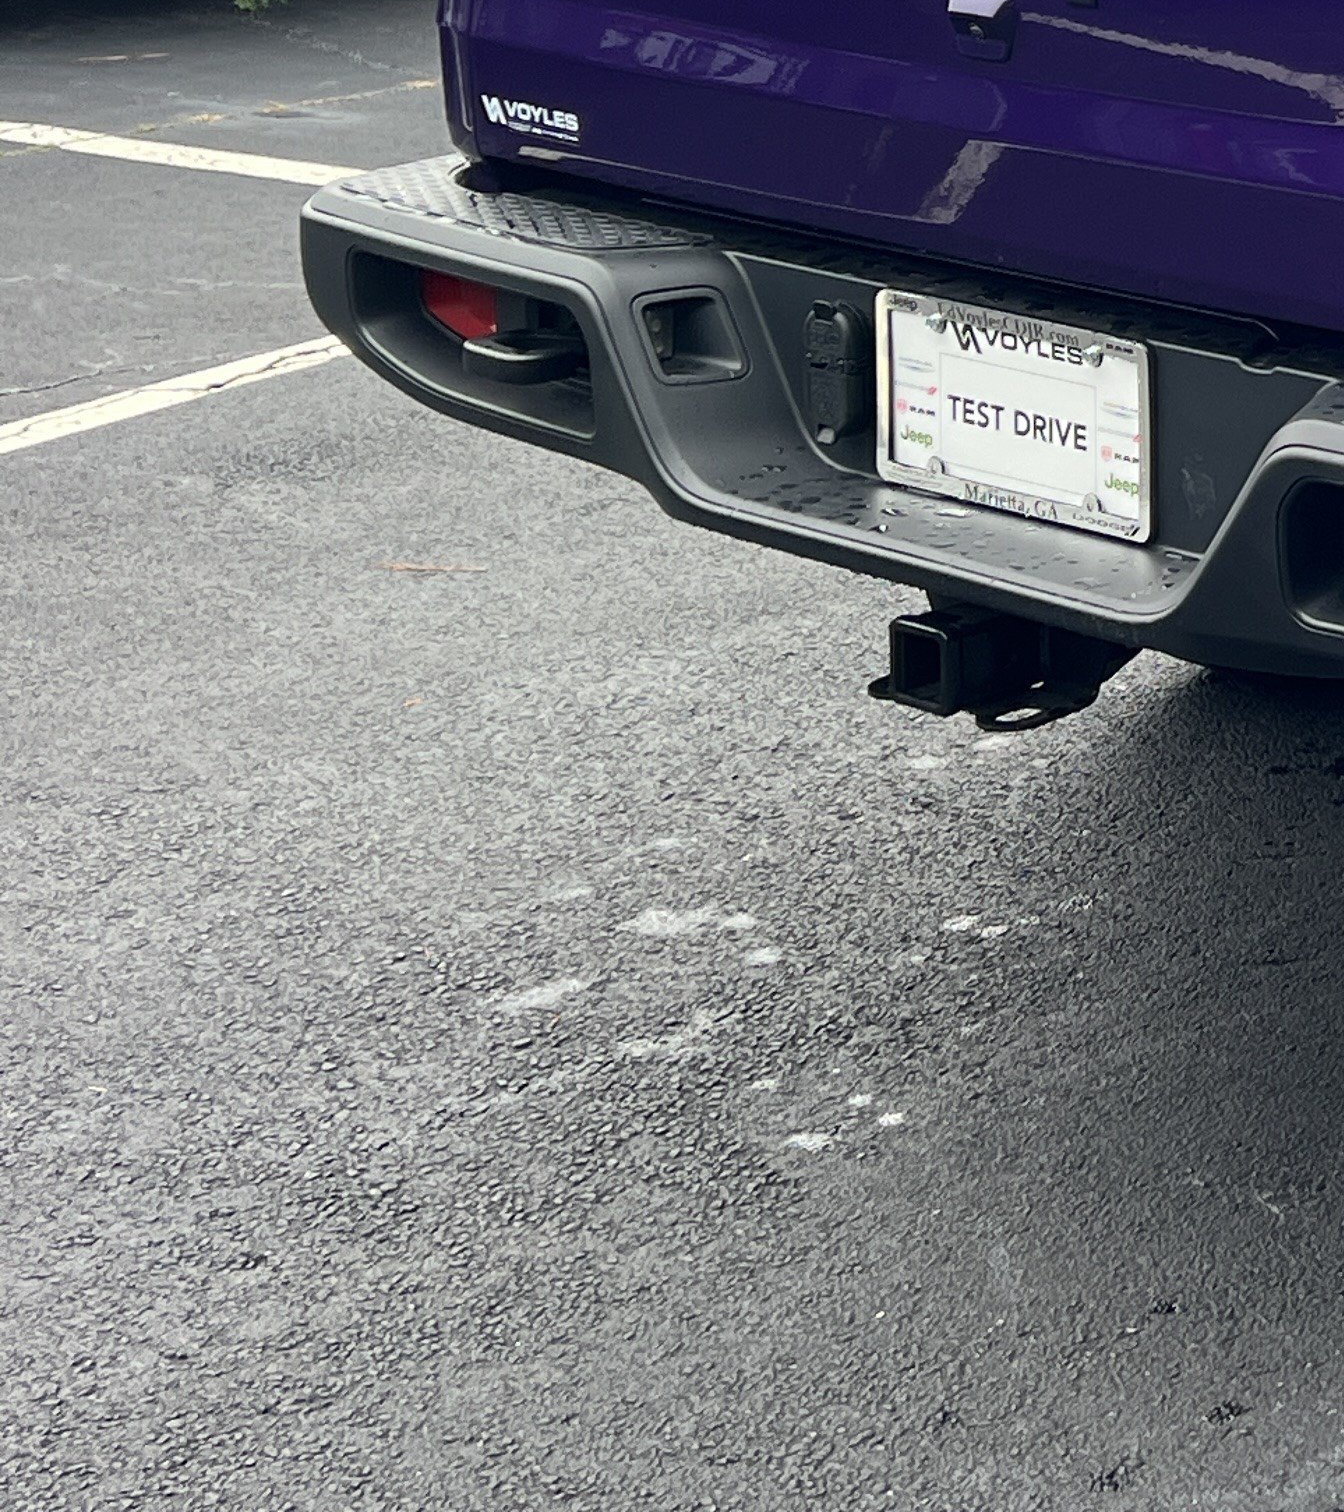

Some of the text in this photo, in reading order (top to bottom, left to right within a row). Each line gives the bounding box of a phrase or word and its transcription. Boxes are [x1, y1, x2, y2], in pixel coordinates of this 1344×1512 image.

[503, 100, 580, 132] VOYLES
[976, 327, 1084, 366] VOYLES
[900, 424, 933, 448] Jeep
[946, 394, 1005, 431] TEST
[1014, 409, 1087, 451] DRIVE
[1104, 472, 1139, 497] Jeep
[1034, 499, 1058, 520] GA
